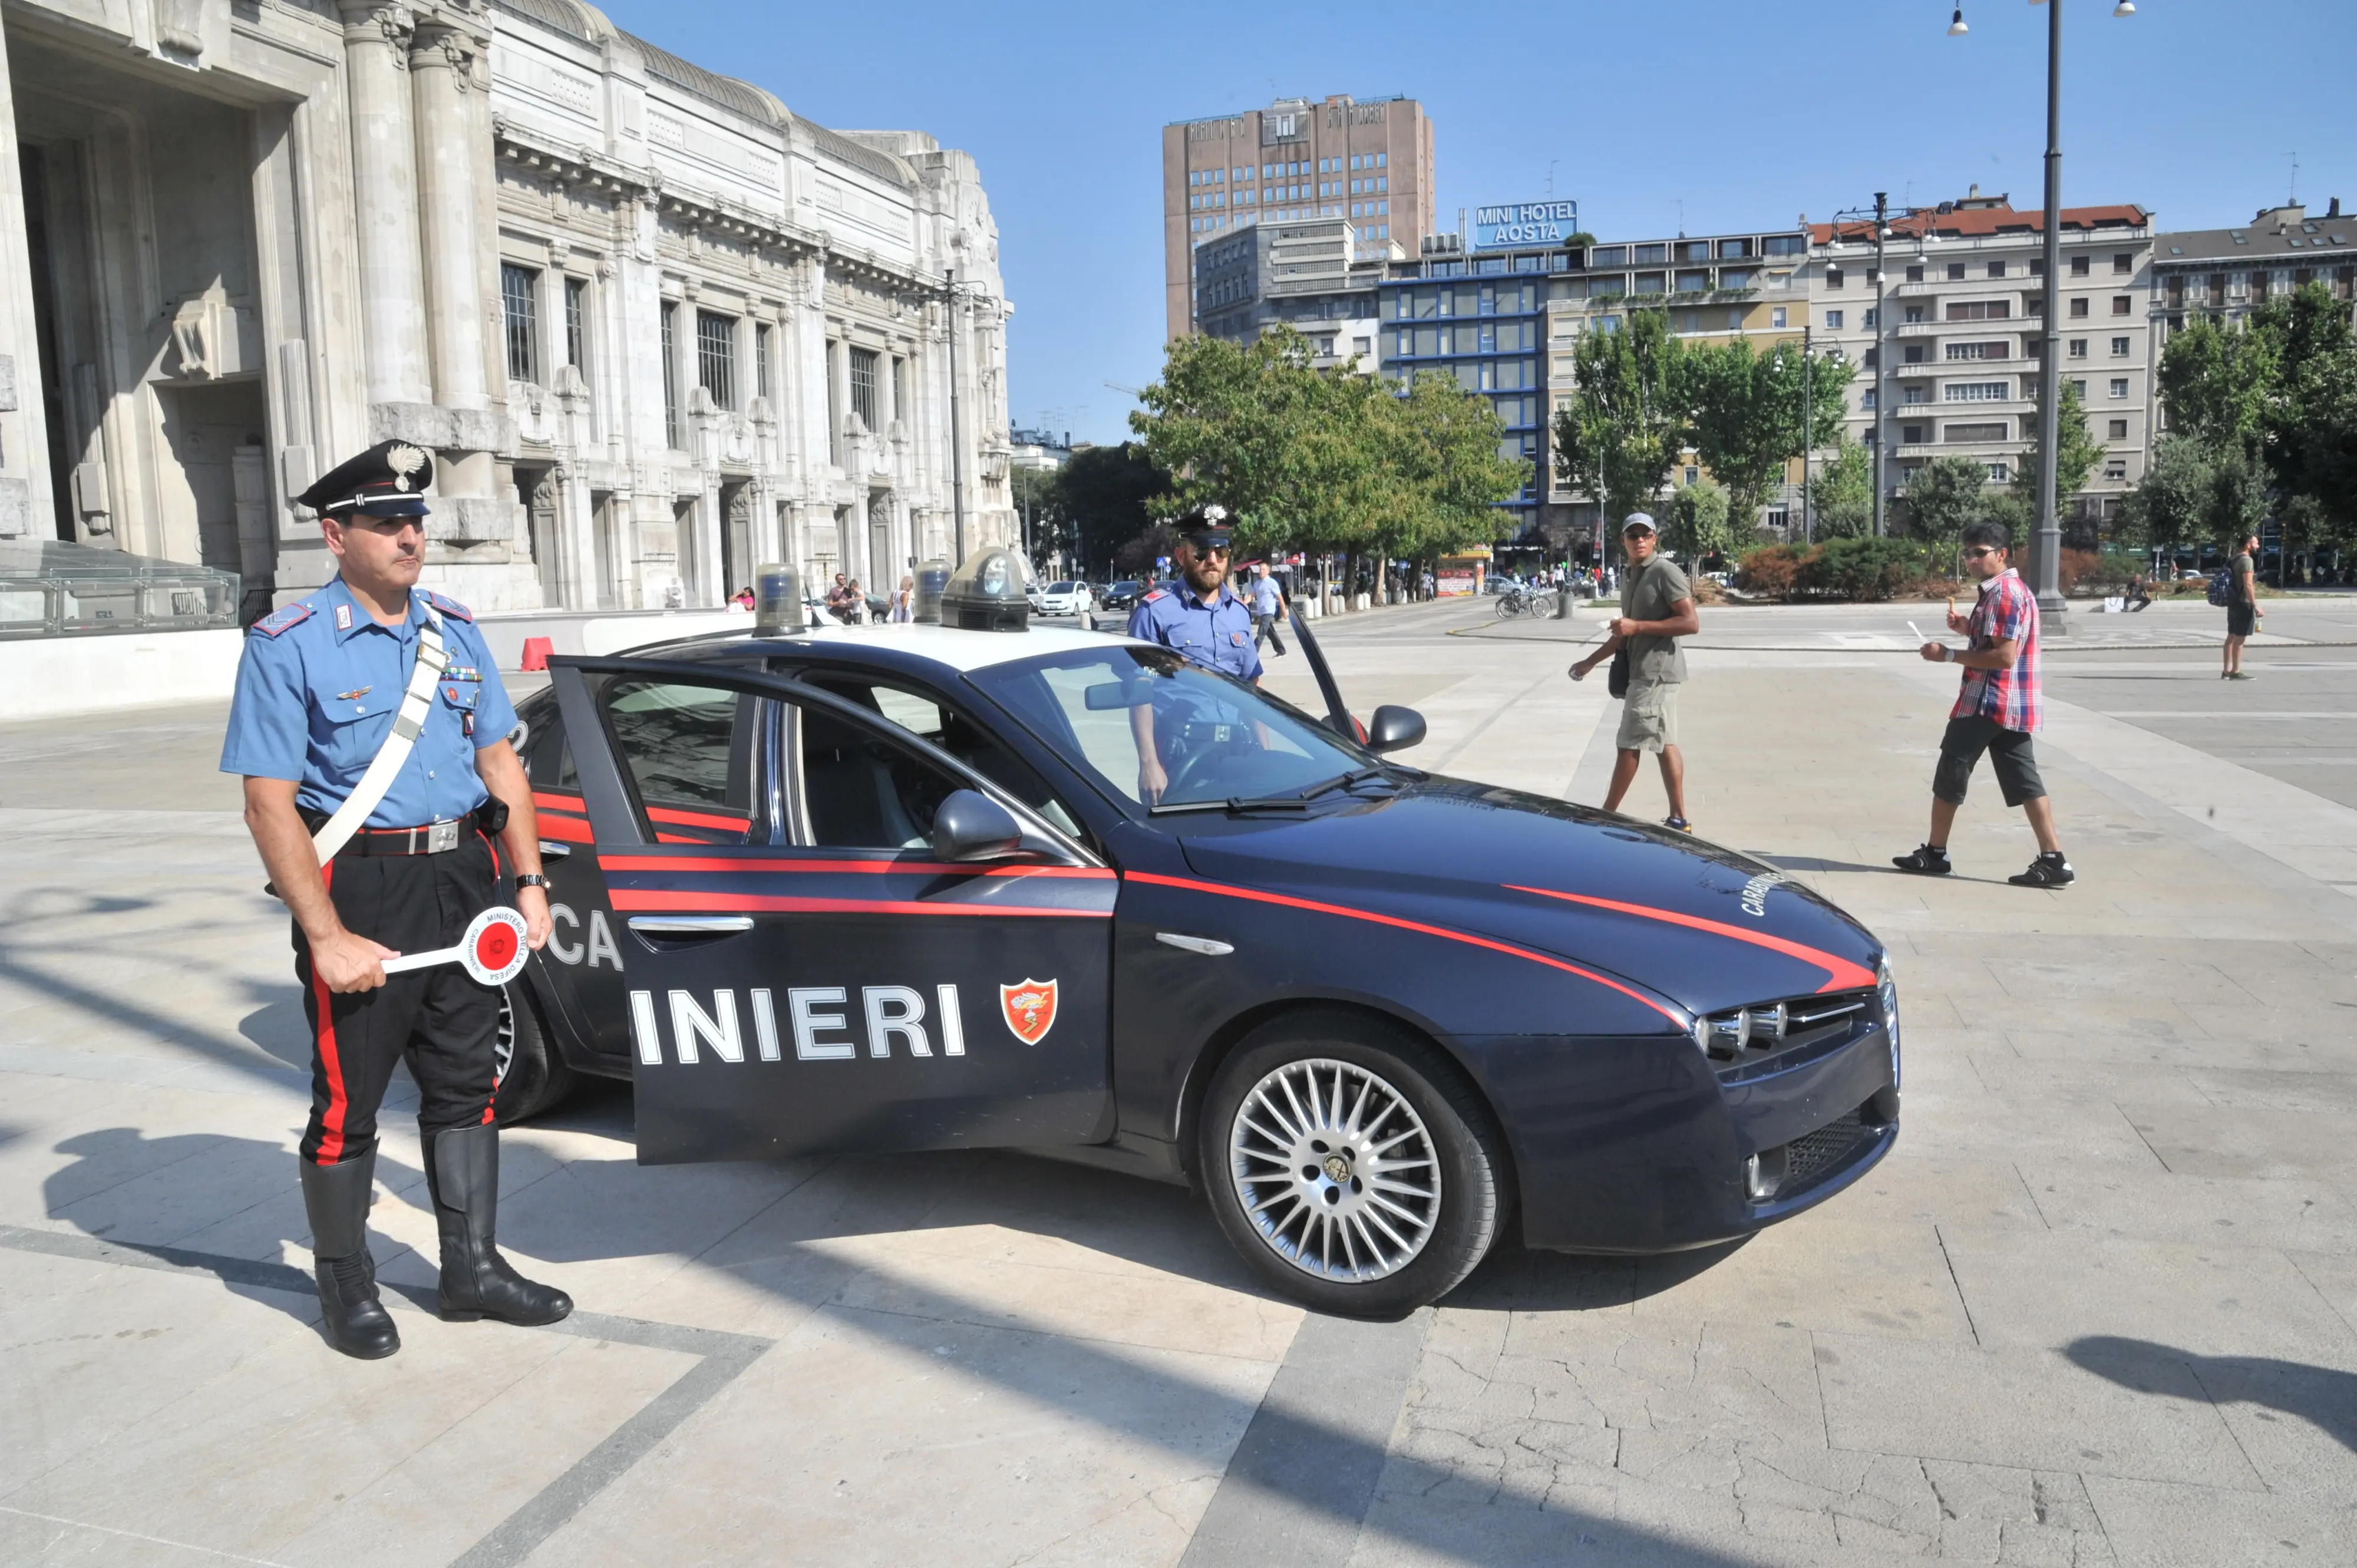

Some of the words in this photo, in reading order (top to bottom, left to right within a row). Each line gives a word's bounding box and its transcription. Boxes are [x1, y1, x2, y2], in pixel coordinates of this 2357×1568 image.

[1478, 207, 1512, 225] MINI
[1520, 203, 1576, 221] HOTEL
[1495, 223, 1560, 242] AOSTA
[487, 912, 524, 933] MINISTERO
[468, 929, 481, 973] CARABINIERI
[516, 936, 527, 964] DELLA
[490, 965, 516, 981] DIFESA
[630, 983, 965, 1065] INIERI
